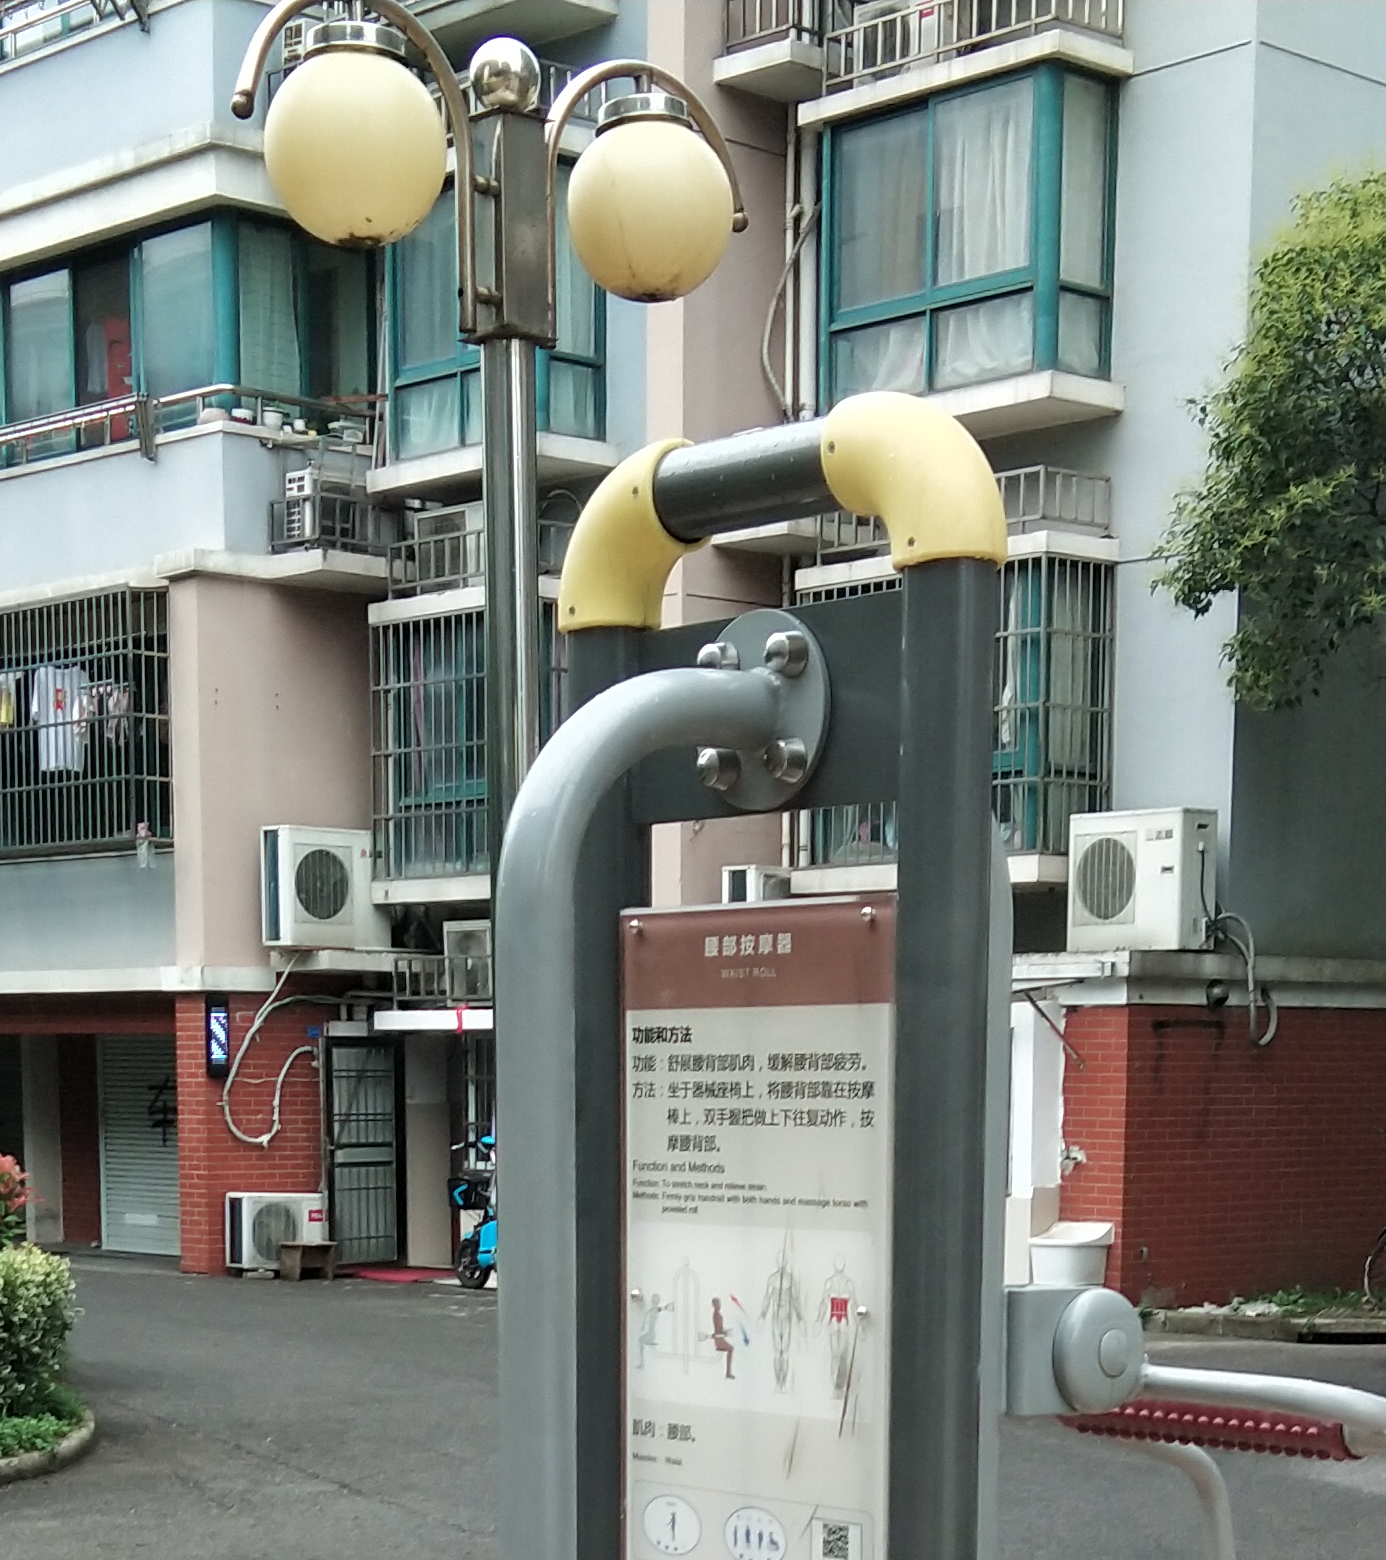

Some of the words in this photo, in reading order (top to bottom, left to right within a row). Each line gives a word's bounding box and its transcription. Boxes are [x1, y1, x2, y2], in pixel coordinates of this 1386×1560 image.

[704, 932, 791, 957] 腰部按摩器
[720, 967, 749, 979] WAIST
[752, 966, 777, 978] ROLL
[631, 1026, 693, 1044] 功能和方法
[632, 1159, 669, 1172] Function
[670, 1161, 686, 1173] and
[688, 1161, 726, 1175] Methods
